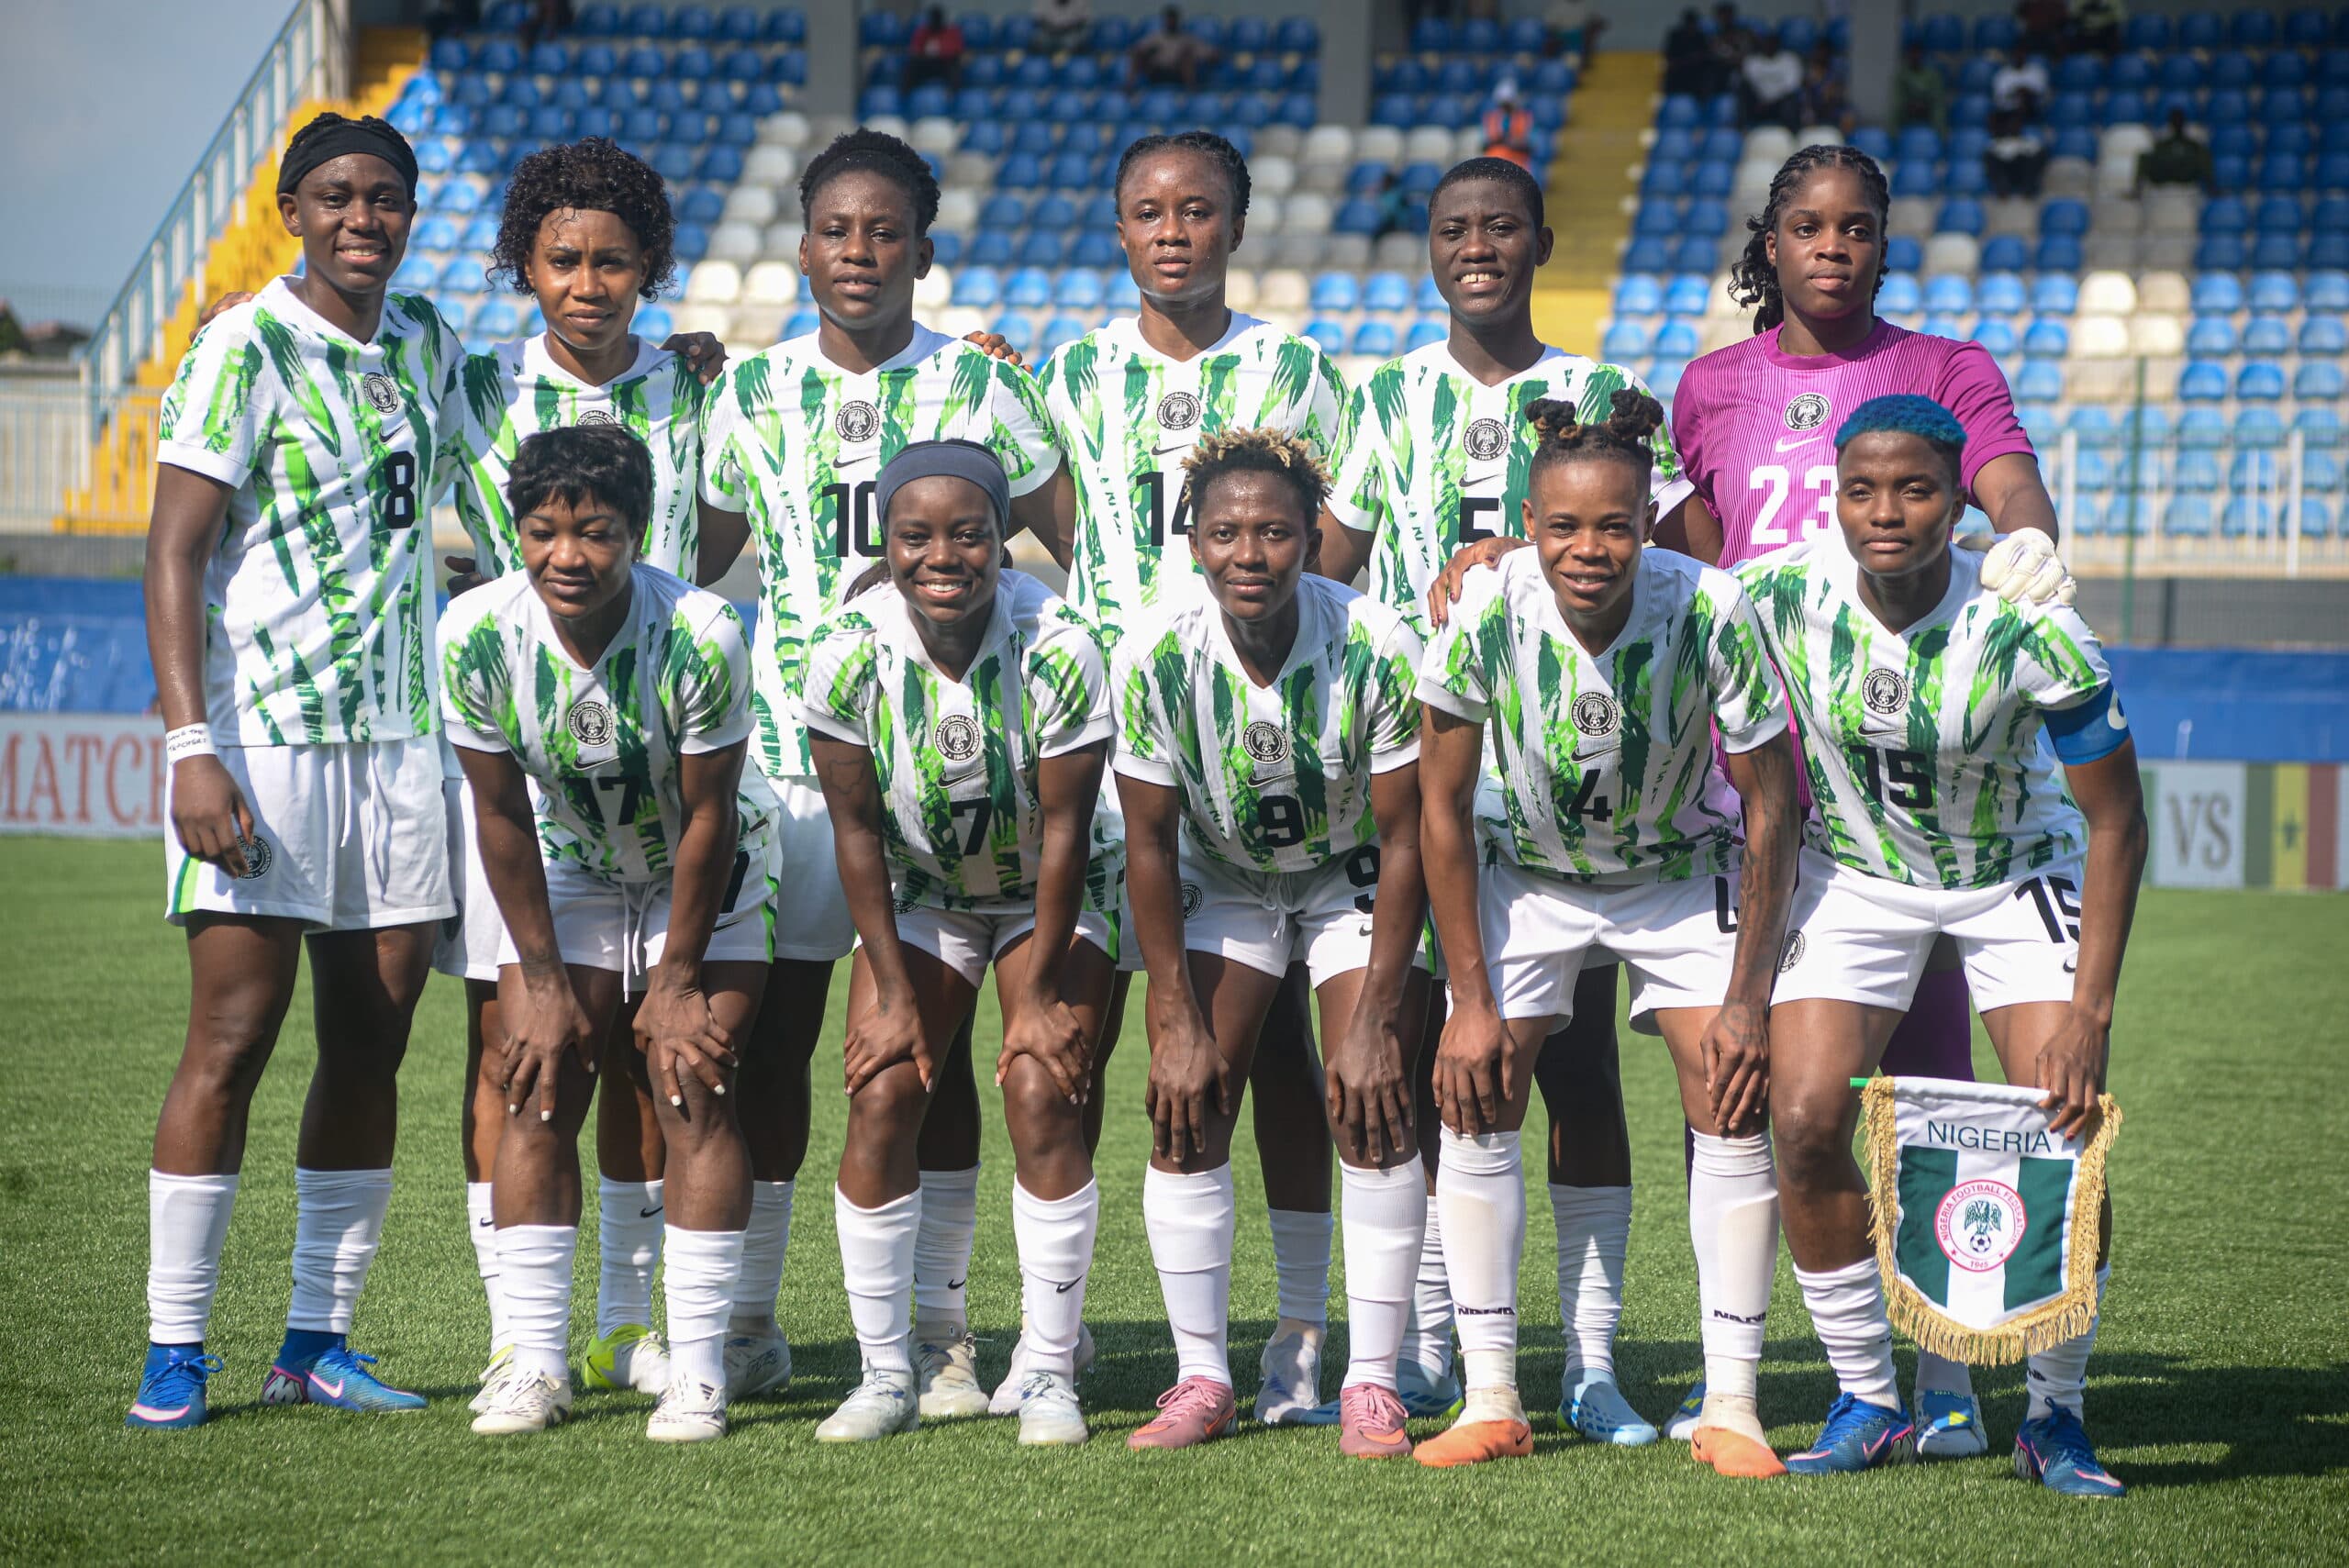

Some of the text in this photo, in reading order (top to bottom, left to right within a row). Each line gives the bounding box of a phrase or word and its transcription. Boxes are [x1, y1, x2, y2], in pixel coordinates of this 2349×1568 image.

[384, 450, 416, 529] 8
[1749, 465, 1838, 544] 23
[1575, 693, 1603, 706] FOOTBALL
[559, 777, 641, 826] 17
[1569, 769, 1612, 822] 4
[1848, 745, 1933, 808] 15
[950, 797, 992, 855] 7
[1258, 795, 1307, 847] 9
[2166, 792, 2231, 870] VS
[1927, 1120, 2052, 1153] NIGERIA
[1939, 1203, 1954, 1240] NIGERIA
[1952, 1184, 2000, 1204] FOOTBALL
